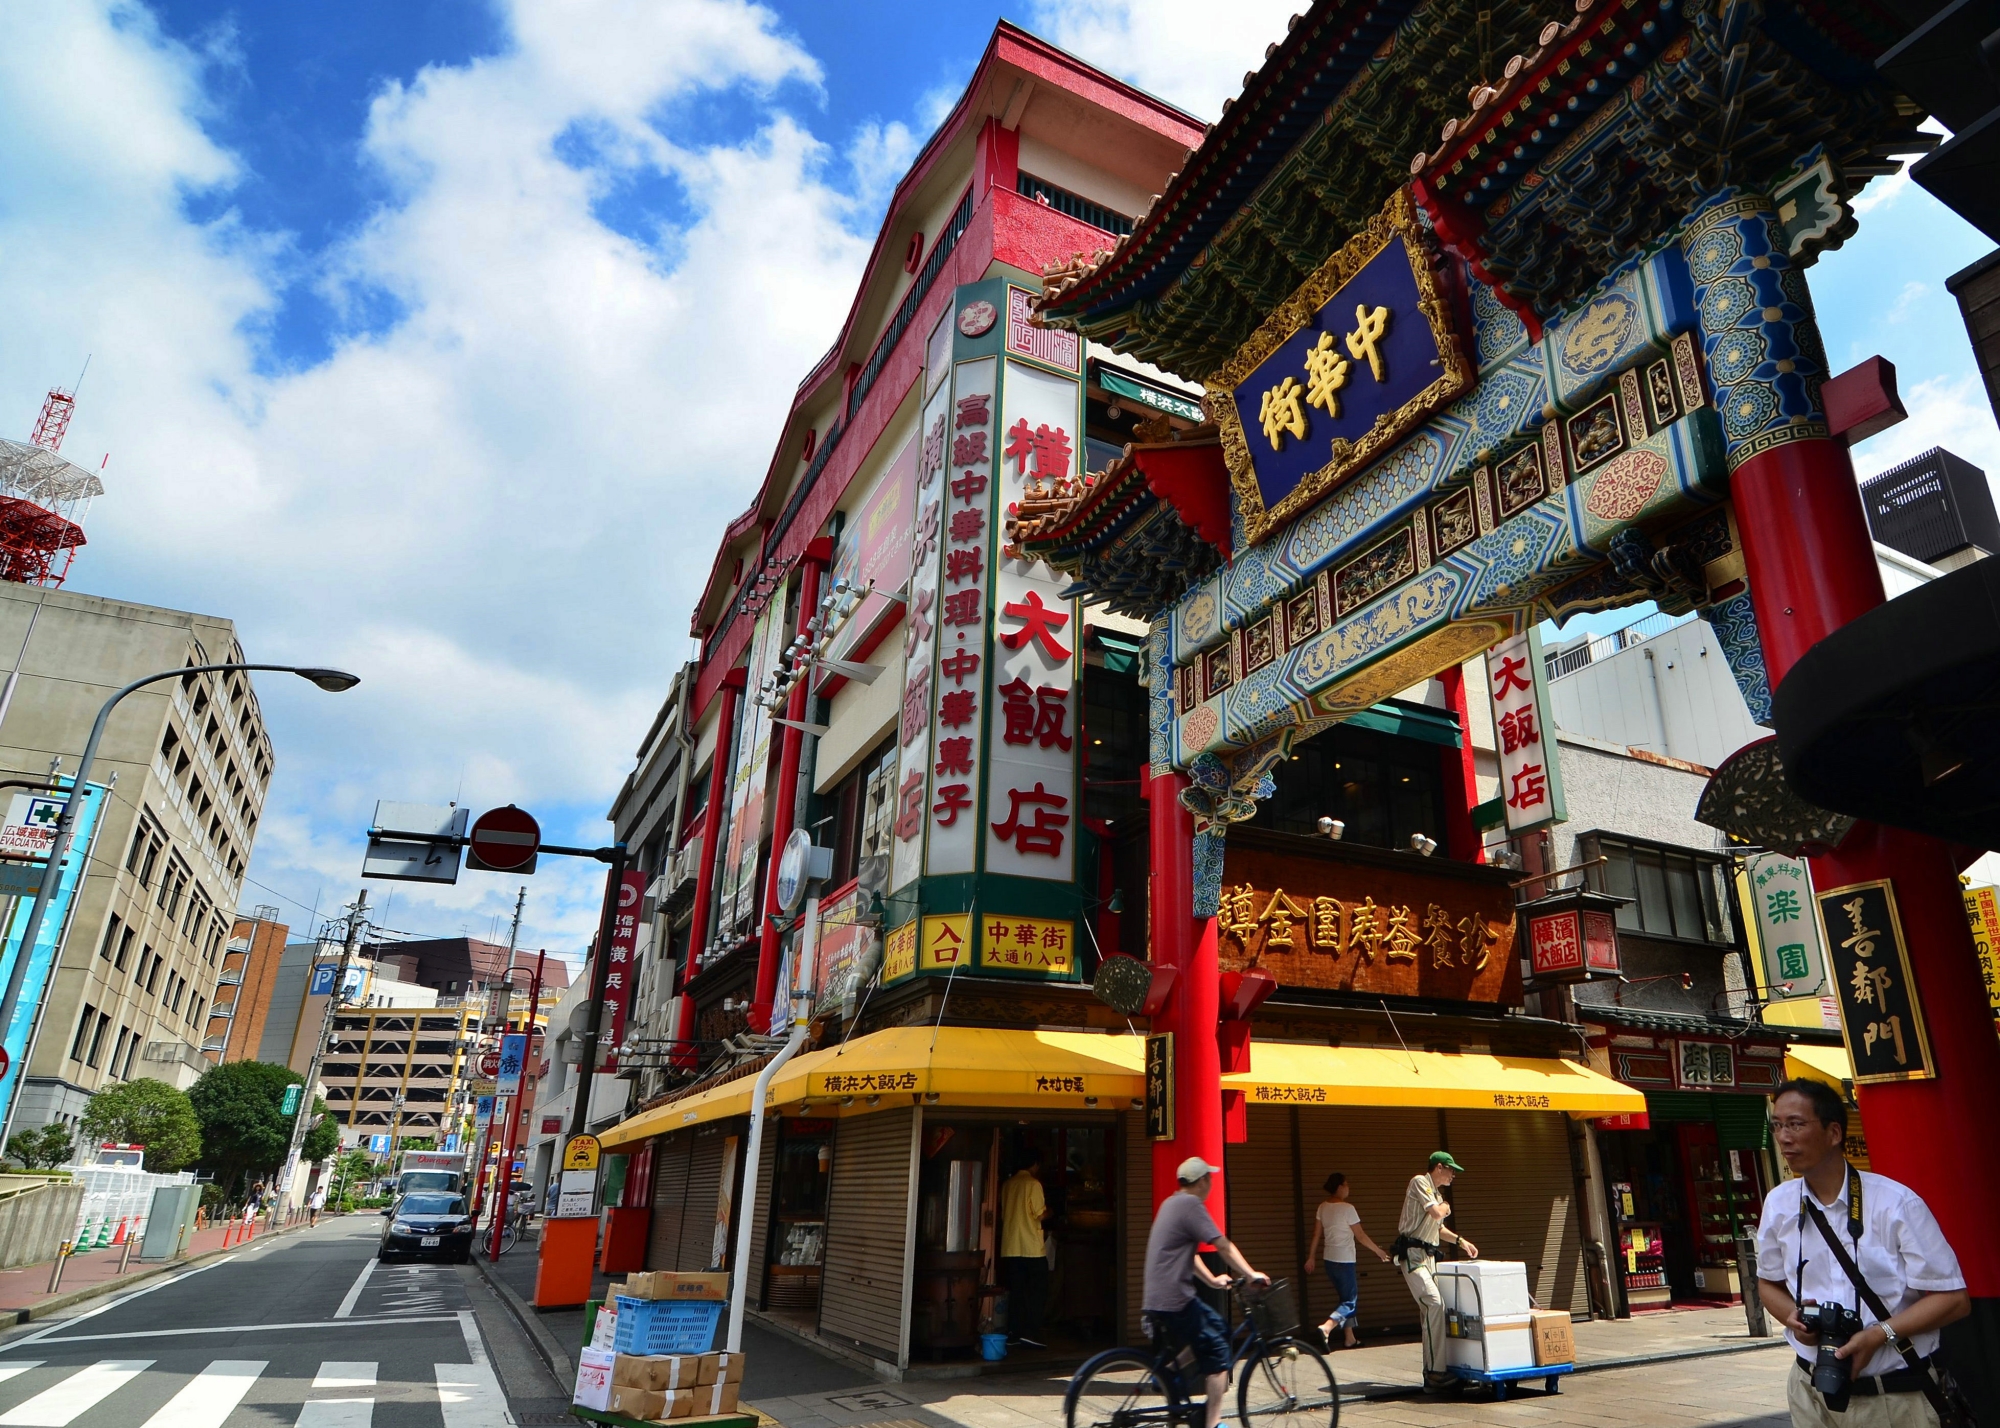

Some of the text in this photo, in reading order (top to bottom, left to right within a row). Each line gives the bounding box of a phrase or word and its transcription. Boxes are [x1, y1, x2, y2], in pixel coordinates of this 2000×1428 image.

[1259, 304, 1389, 450] 中華街
[895, 413, 945, 843] 横浜大飯店
[991, 417, 1073, 858] 横大飯店
[1489, 641, 1545, 810] 大飯店
[0, 836, 46, 849] EVACUATION
[1756, 862, 1802, 889] 廣東料理
[888, 929, 916, 958] 中華街
[932, 922, 965, 963] 入口
[987, 921, 1067, 950] 中華街
[1535, 918, 1574, 945] 横濱
[1766, 889, 1809, 979] 楽園
[987, 947, 1066, 966] 大通り入口
[1538, 941, 1576, 967] 大飯店
[483, 1059, 501, 1068] 消火
[1682, 1043, 1733, 1083] 楽園
[824, 1072, 918, 1092] 横浜大飯店
[1036, 1076, 1085, 1093] 大粒甘栗
[1255, 1086, 1327, 1102] 横浜大飯店
[1493, 1094, 1550, 1108] 横浜大飯店
[1851, 1198, 1860, 1221] Nikon
